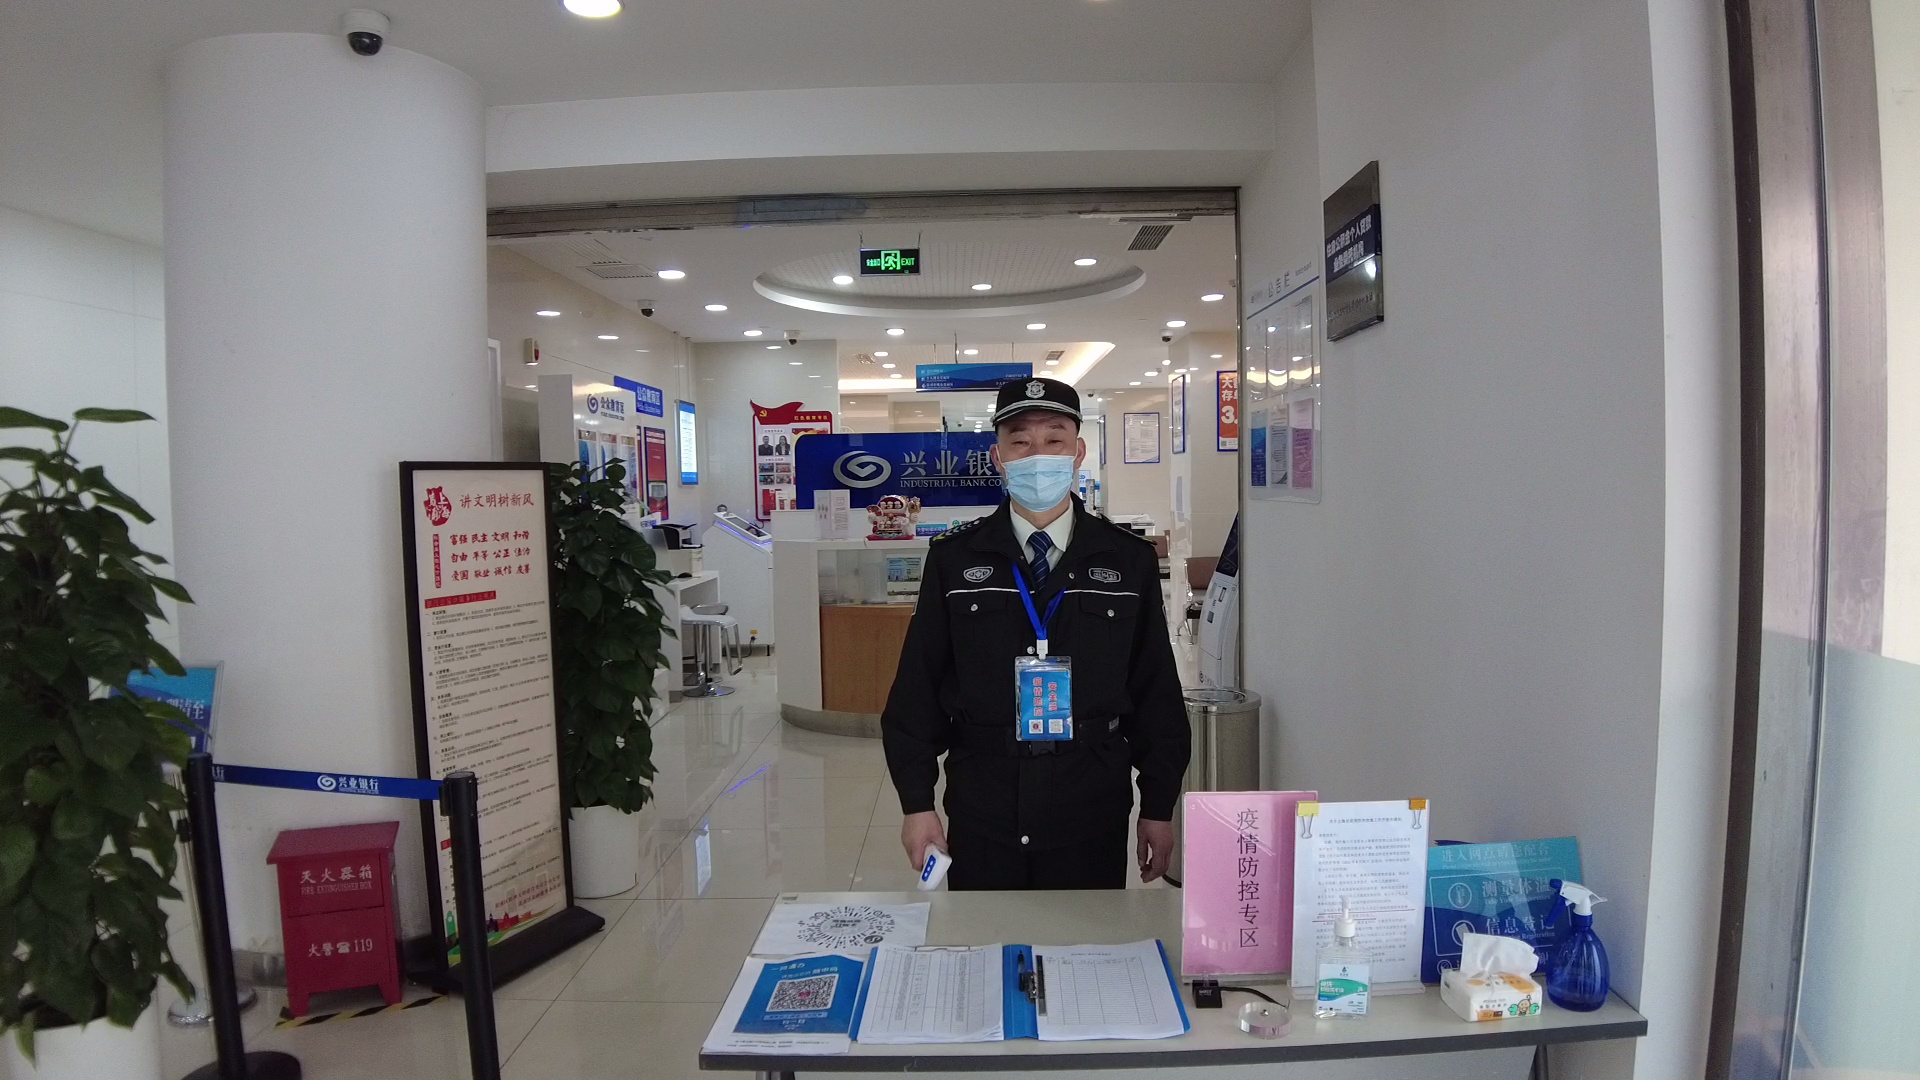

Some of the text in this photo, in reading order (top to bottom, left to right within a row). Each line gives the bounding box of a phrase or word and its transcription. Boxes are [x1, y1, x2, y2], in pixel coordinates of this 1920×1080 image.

[901, 257, 916, 266] EXIT
[900, 479, 959, 488] INDUSTRIAL
[960, 478, 986, 487] BANK
[459, 494, 534, 509] 讲文明树新风
[449, 530, 530, 546] 富强 民主 文明 和谐
[451, 546, 531, 563] 自由 平等 公正 法治
[451, 563, 531, 581] 爱国 敬业 诚信 友善
[338, 776, 379, 791] 兴业银行
[1442, 842, 1550, 862] 进入网点请您配合
[300, 864, 372, 885] 灭火器箱
[1236, 807, 1260, 948] 疫情防控专区
[300, 880, 372, 896] FIRE EXTINGUISHER BOX
[1482, 876, 1551, 898] 测量体温
[1486, 914, 1555, 935] 信息登记
[308, 938, 373, 958] 火警 119
